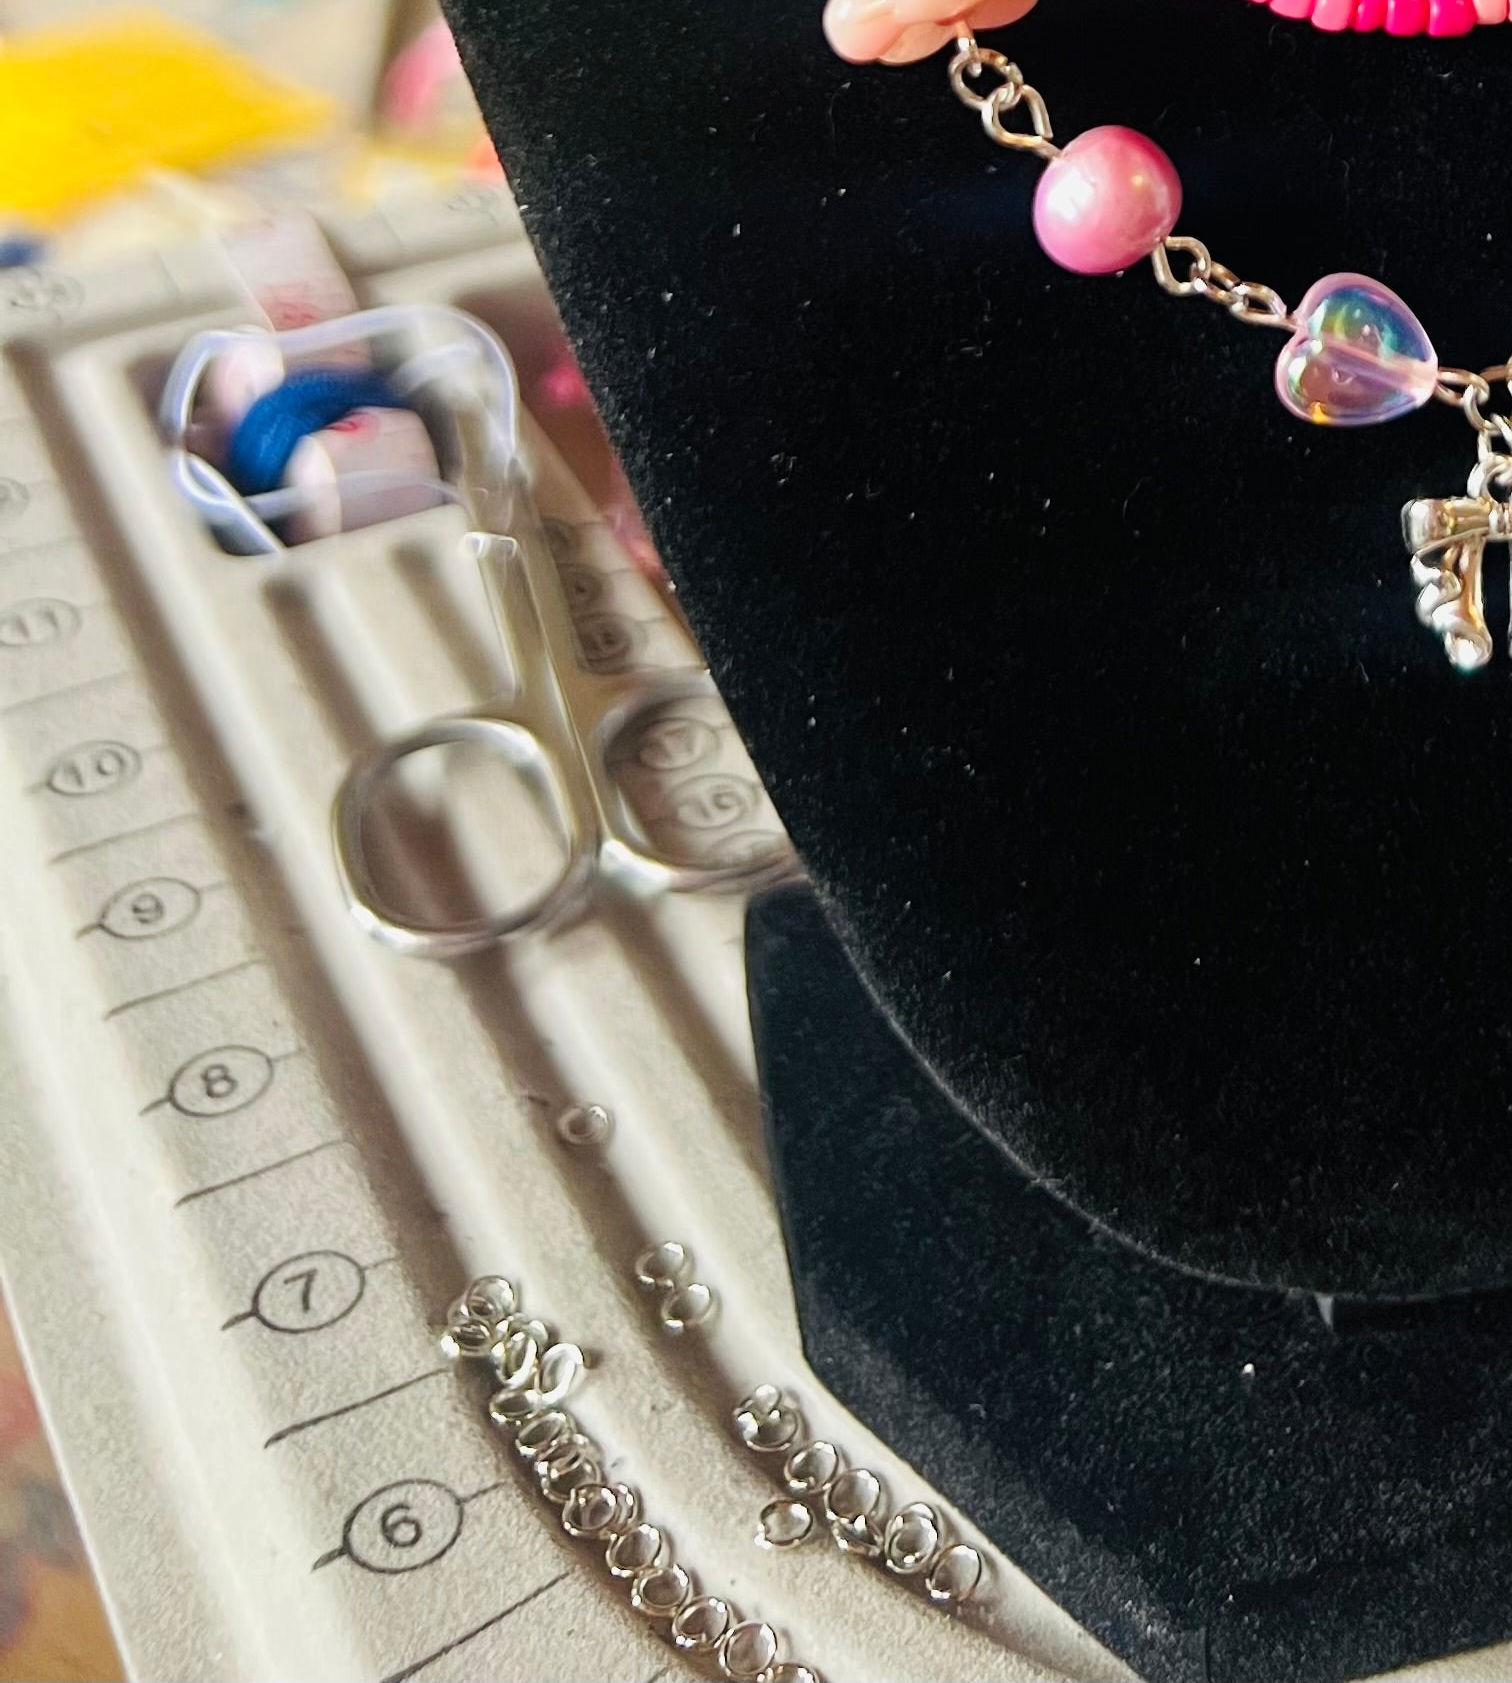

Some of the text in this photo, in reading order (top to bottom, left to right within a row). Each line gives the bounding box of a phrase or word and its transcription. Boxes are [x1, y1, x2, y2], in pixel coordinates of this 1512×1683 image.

[62, 749, 126, 789] 10
[131, 892, 165, 925] 9
[200, 1062, 238, 1099] 8
[283, 1268, 319, 1314] 7
[380, 1503, 423, 1549] 6
